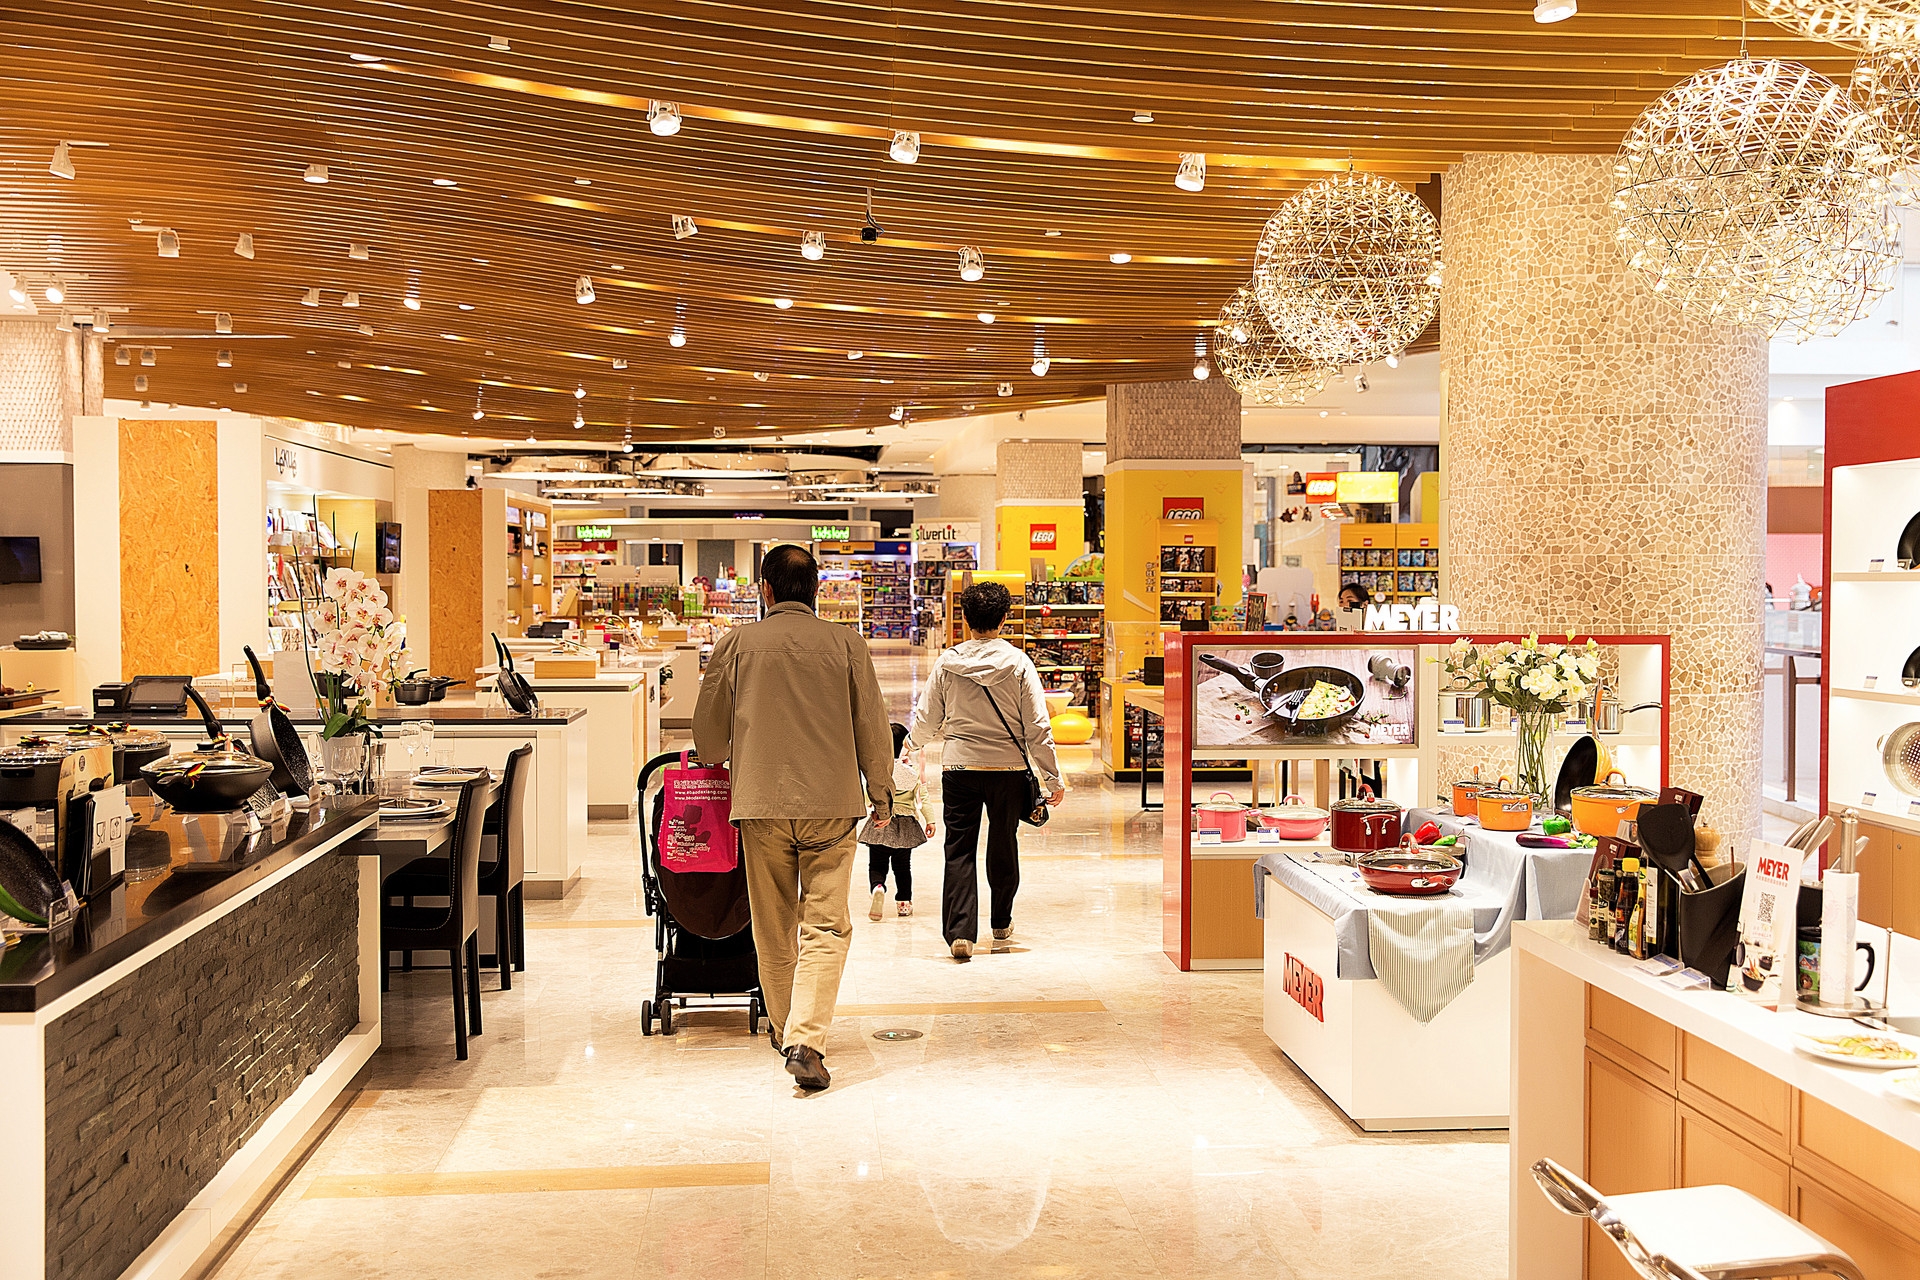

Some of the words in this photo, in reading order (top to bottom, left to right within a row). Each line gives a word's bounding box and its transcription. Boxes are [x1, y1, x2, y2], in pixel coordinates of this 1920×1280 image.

[1307, 480, 1337, 496] LEGO
[1031, 530, 1055, 543] LEGO
[1364, 604, 1460, 631] MEYER
[1370, 723, 1409, 736] MEYER
[1757, 857, 1789, 880] MEYER
[1283, 952, 1324, 1022] MEYER
